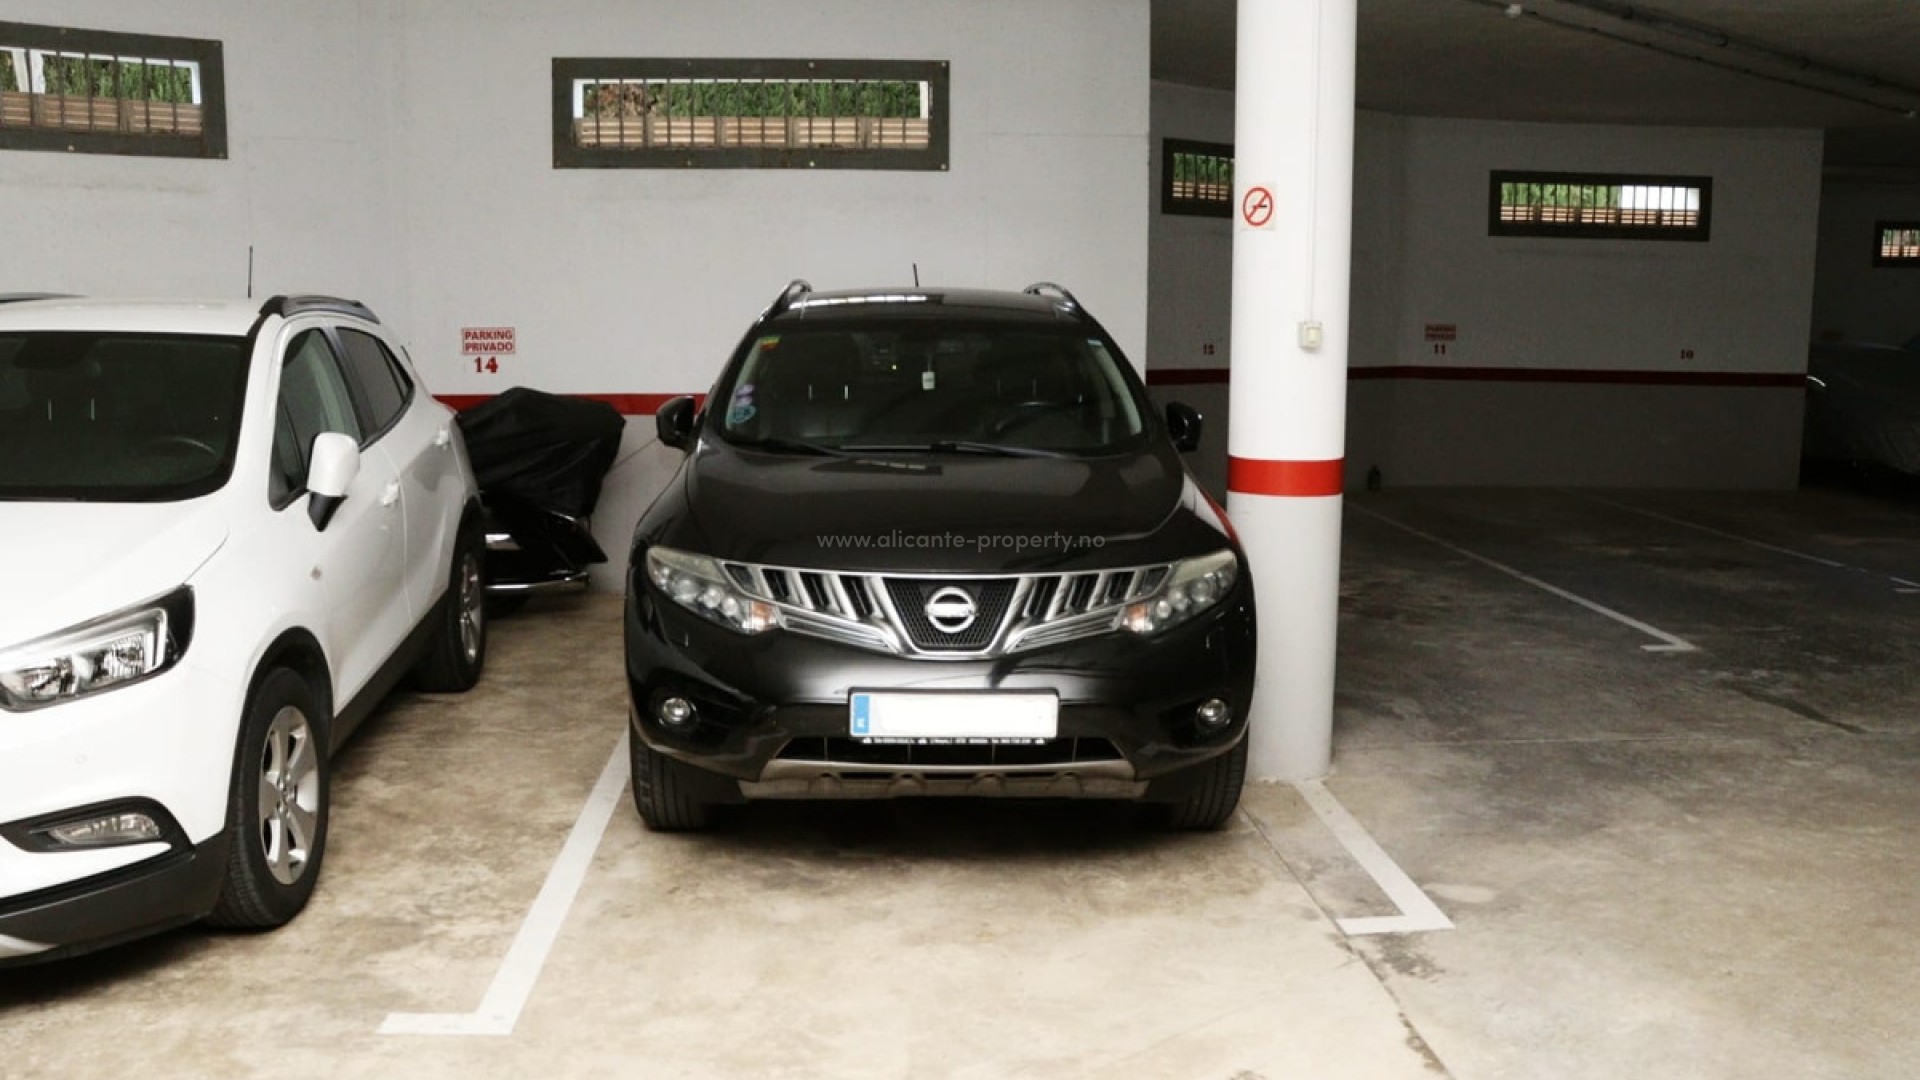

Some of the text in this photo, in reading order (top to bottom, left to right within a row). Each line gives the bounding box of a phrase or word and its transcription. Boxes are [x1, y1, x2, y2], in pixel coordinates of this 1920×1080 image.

[465, 330, 513, 340] PARKING
[465, 341, 513, 351] PRIVADO
[1434, 343, 1446, 355] 11
[474, 356, 498, 373] 14
